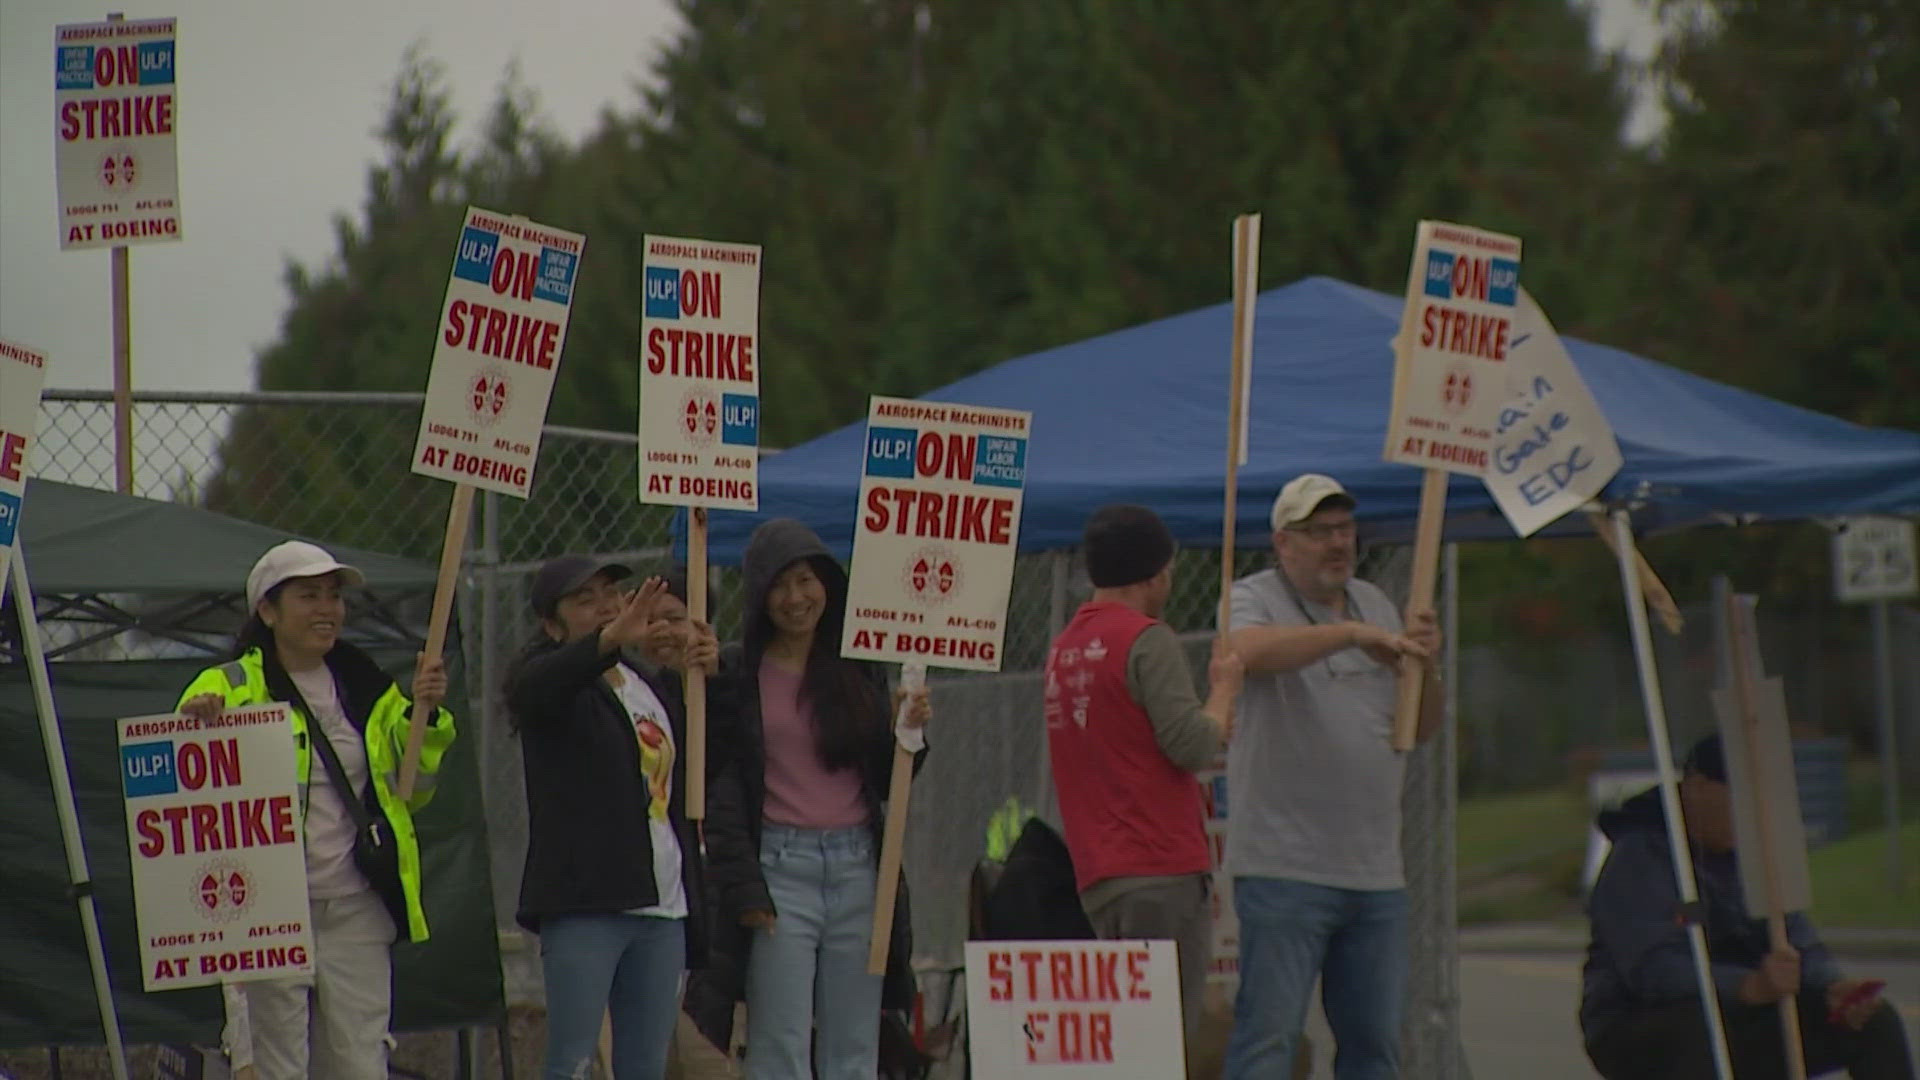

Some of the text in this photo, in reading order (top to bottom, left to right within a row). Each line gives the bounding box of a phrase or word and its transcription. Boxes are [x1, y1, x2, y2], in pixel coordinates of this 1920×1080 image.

[61, 24, 173, 40] AEROSPACE MACHINISTS
[94, 46, 138, 86] ON
[141, 51, 172, 70] ULP!
[61, 95, 172, 142] STRIKE
[66, 200, 174, 216] LODGE 751 AFL-CIO
[68, 218, 177, 244] AT BOEING
[470, 214, 580, 253] AEROSPACE MACHINISTS
[462, 239, 493, 266] ULP!
[650, 242, 756, 265] AEROSPACE MACHINISTS
[490, 248, 540, 302] ON
[648, 280, 678, 300] ULP!
[1452, 254, 1490, 302] ON
[680, 269, 722, 318] ON
[444, 299, 560, 370] STRIKE
[1420, 304, 1512, 362] STRIKE
[647, 327, 754, 383] STRIKE
[724, 407, 756, 428] ULP!
[876, 402, 1026, 430] AEROSPACE MACHINISTS
[428, 422, 531, 456] LODGE 751 AFL-CIO
[872, 438, 912, 461] ULP!
[988, 438, 1017, 452] UNFAIR
[1402, 436, 1489, 468] AT BOEING
[1494, 411, 1570, 474] Gate
[422, 446, 527, 487] AT BOEING
[647, 451, 752, 470] LODGE 751 AFL-CIO
[916, 431, 976, 482] ON
[986, 452, 1014, 466] LABOR
[648, 474, 754, 500] AT BOEING
[1519, 445, 1595, 506] EDC
[864, 486, 1014, 546] STRIKE
[855, 608, 997, 630] LODGE 751 AFL-CIO
[852, 630, 995, 660] AT BOEING
[126, 709, 285, 738] AEROSPACE ACHINISTS
[128, 754, 172, 778] ULP!
[177, 738, 242, 790] ON
[136, 796, 296, 858] STRIKE
[150, 922, 302, 948] LODGE 751 AFL-CIO
[154, 946, 307, 980] AT BOEING
[988, 950, 1152, 1001] STRIKE
[1026, 1012, 1114, 1063] FOR
